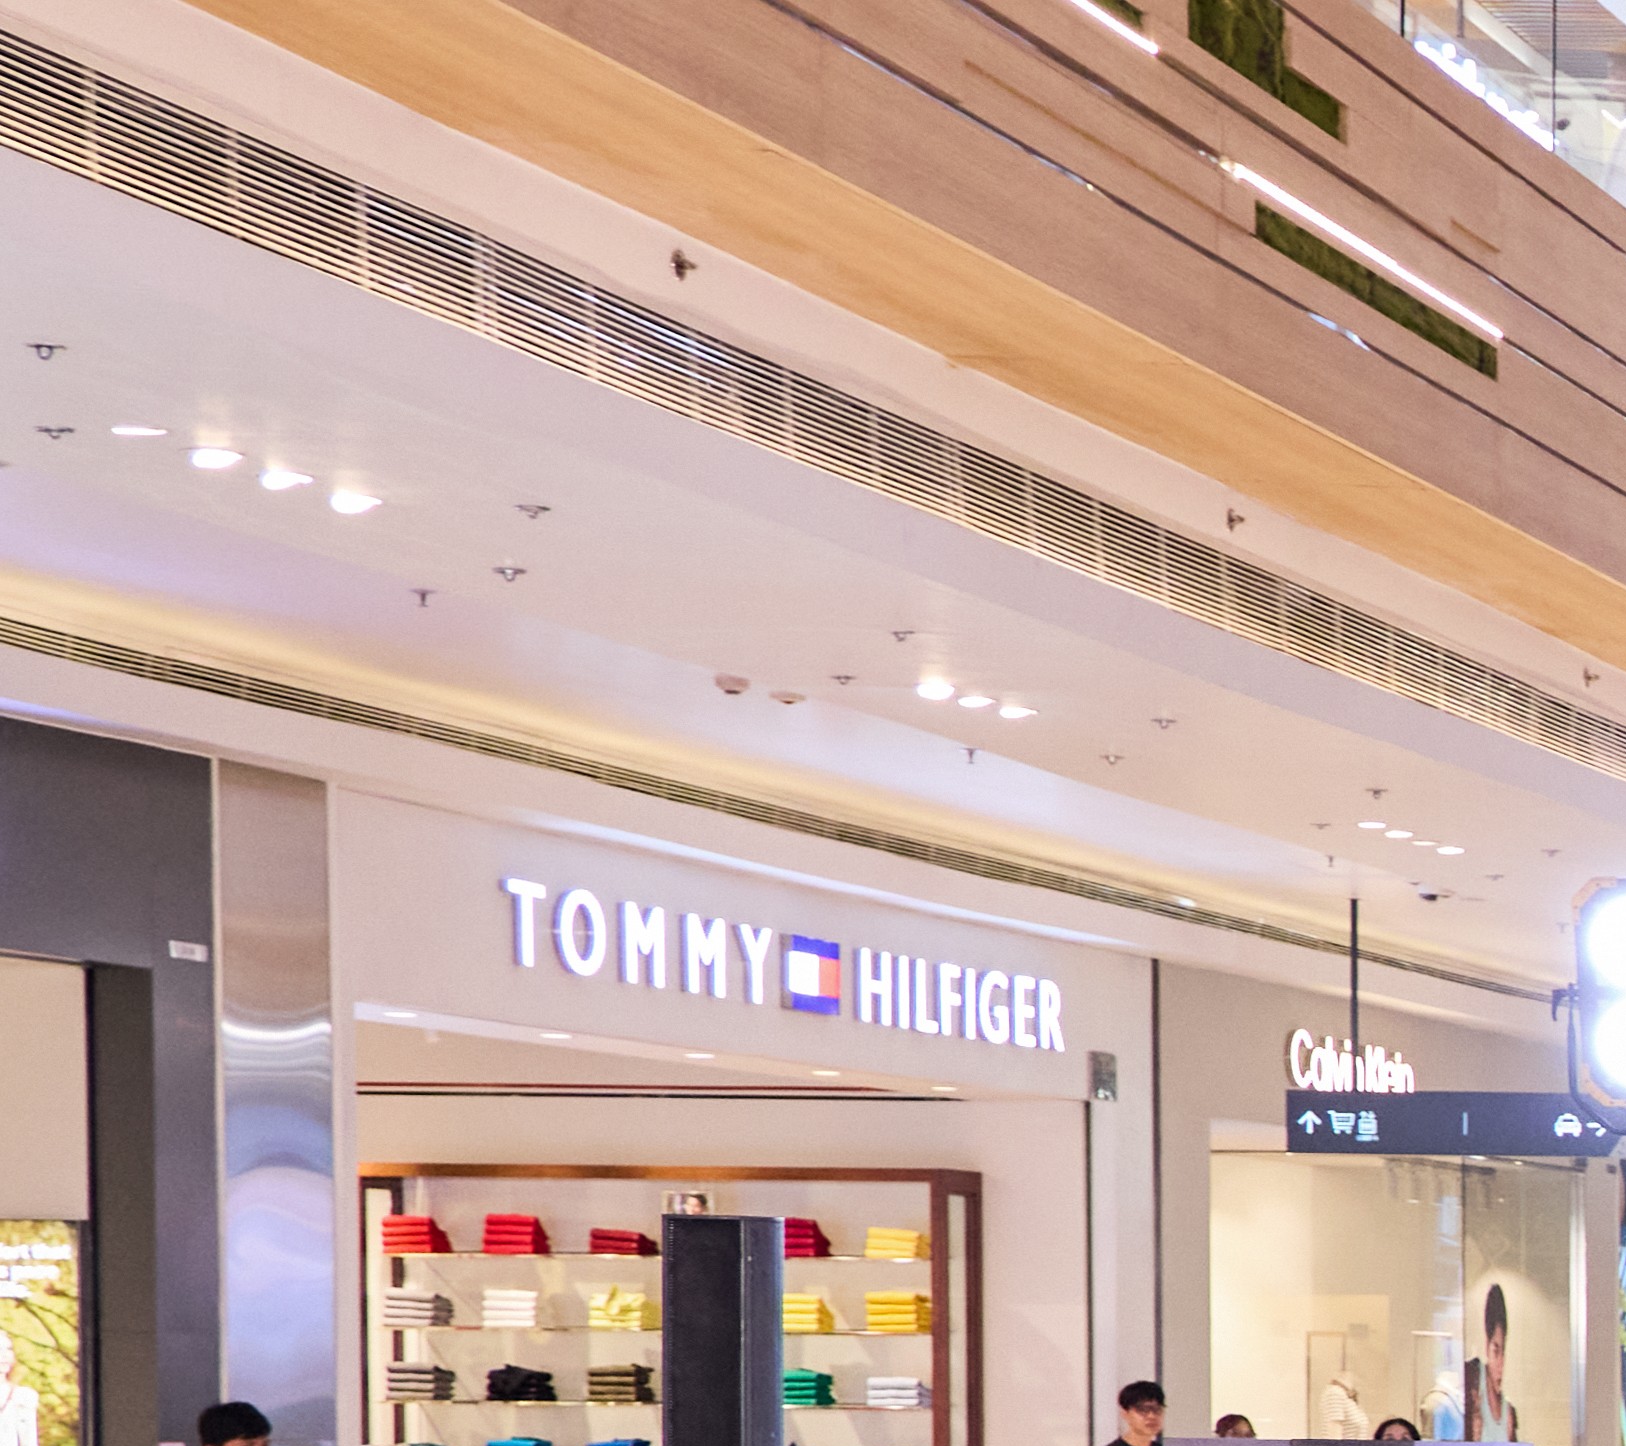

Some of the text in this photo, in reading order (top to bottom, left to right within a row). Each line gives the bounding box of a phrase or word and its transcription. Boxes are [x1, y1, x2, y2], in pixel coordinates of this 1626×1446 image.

[504, 876, 1065, 1052] TOMMY HILFIGER
[1290, 1029, 1415, 1093] Calvin Klein
